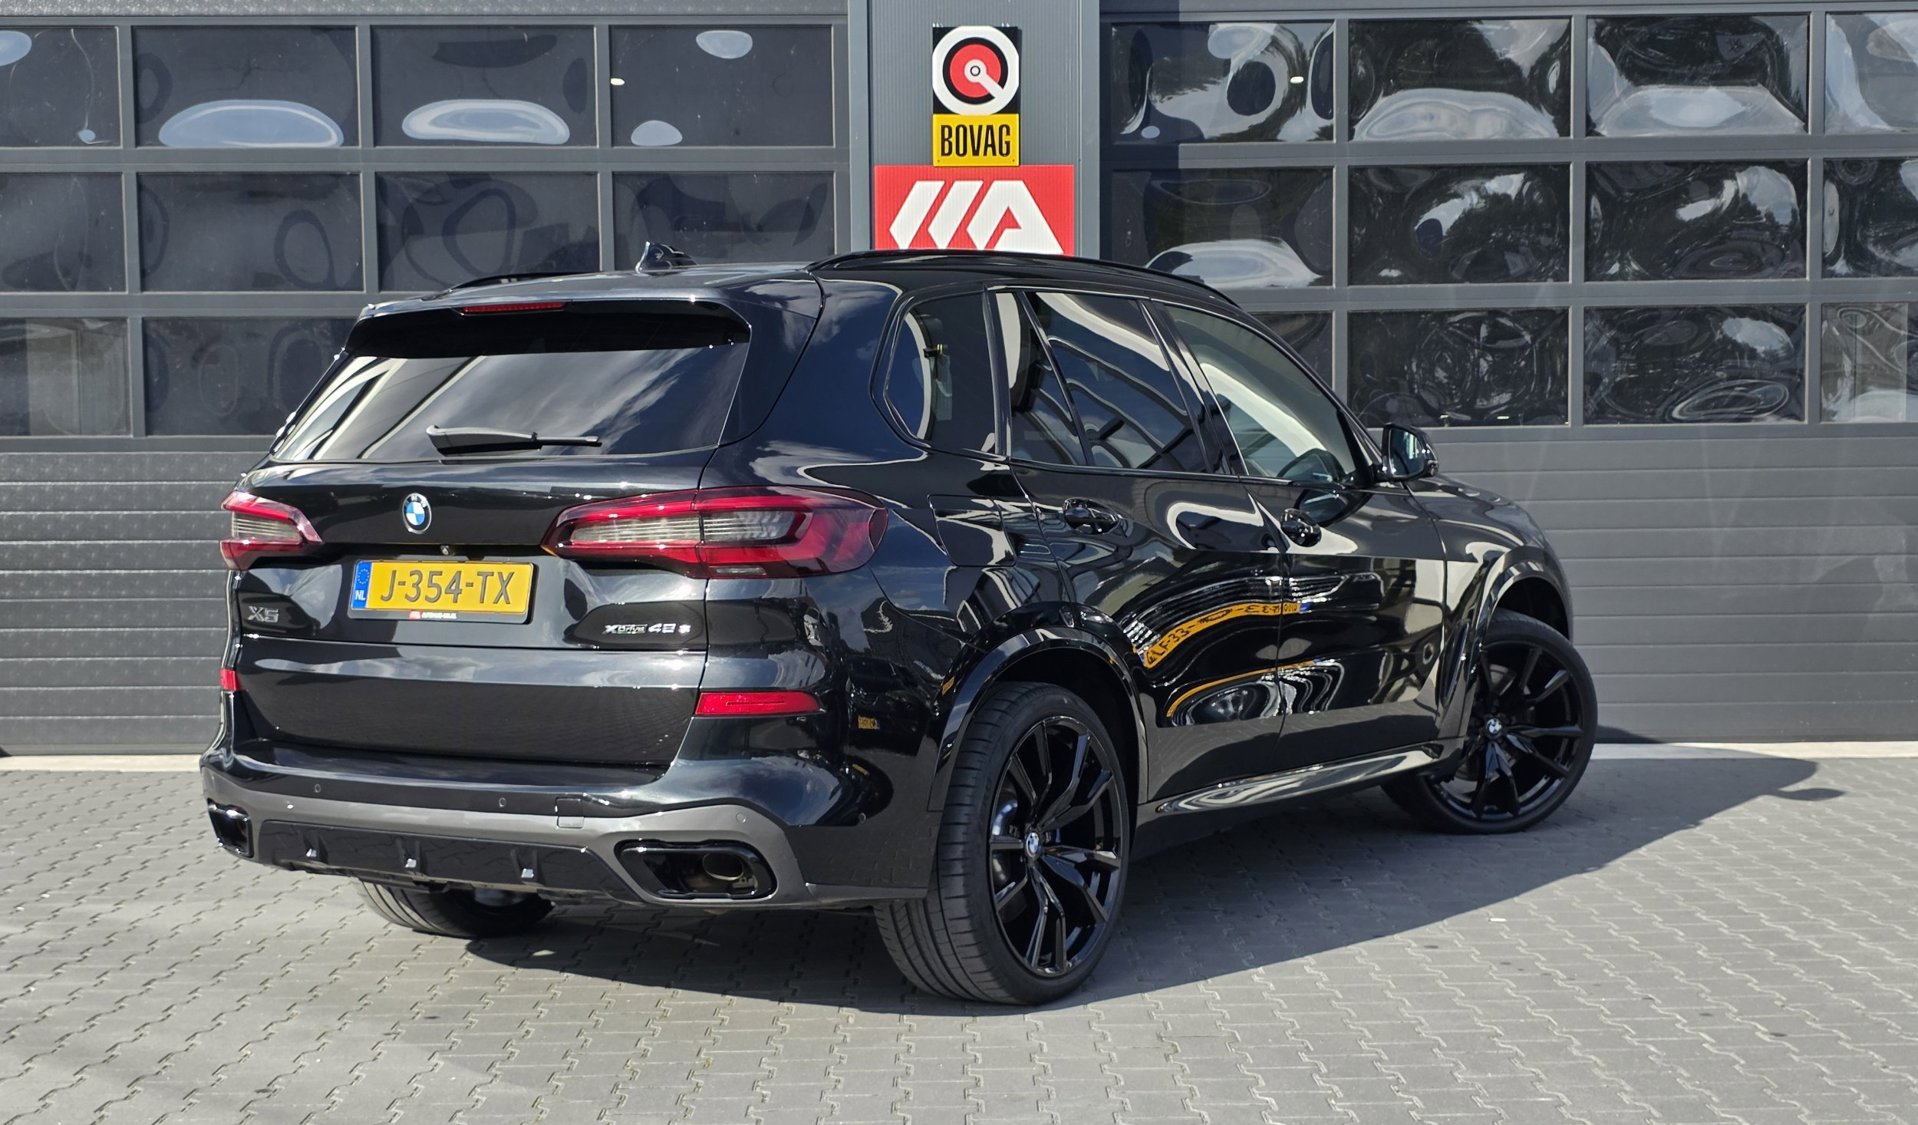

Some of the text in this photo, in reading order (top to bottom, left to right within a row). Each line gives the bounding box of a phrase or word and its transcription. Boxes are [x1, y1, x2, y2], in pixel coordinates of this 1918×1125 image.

[940, 124, 1011, 157] BOVAG
[355, 590, 366, 601] NL
[380, 570, 515, 605] J-354-TX
[247, 605, 280, 623] X5
